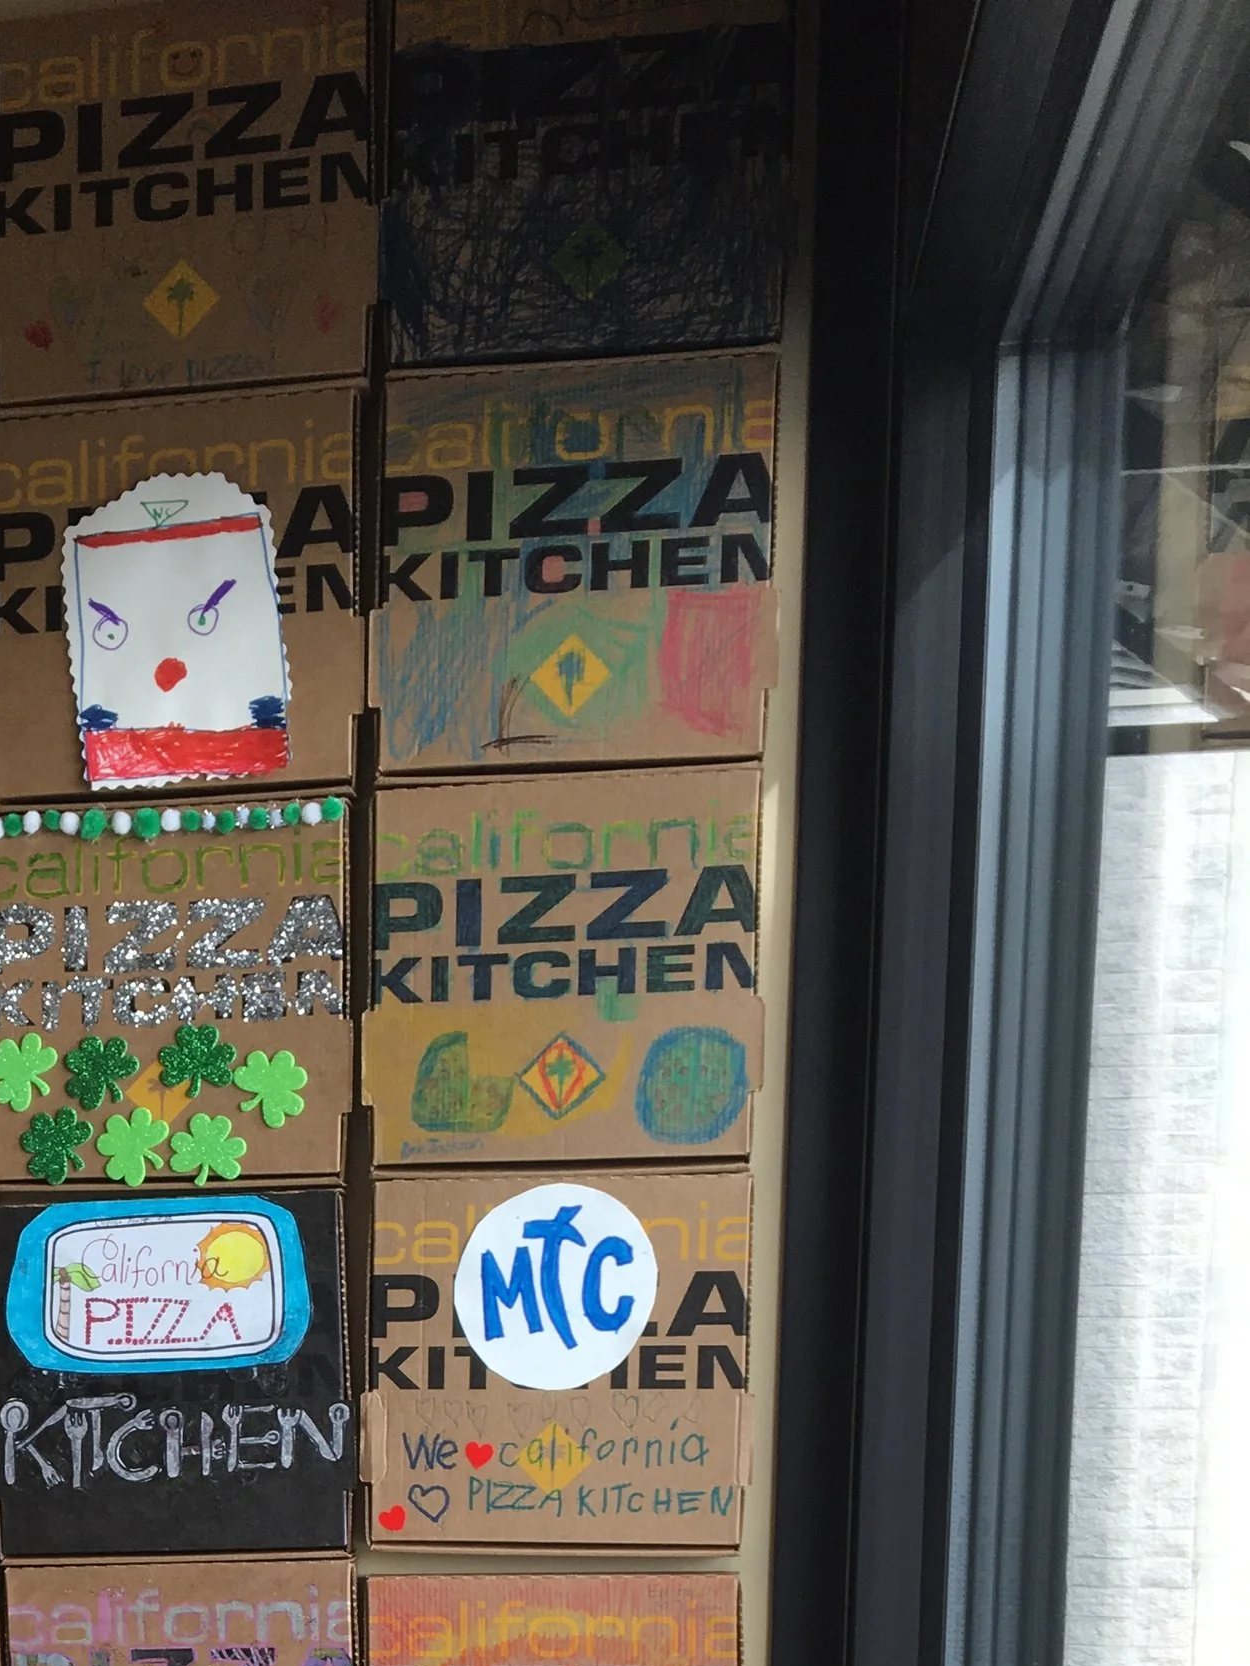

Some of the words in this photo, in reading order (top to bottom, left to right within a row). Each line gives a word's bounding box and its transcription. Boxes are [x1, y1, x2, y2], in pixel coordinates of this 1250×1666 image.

[384, 452, 772, 547] PIZZA
[385, 532, 772, 605] KITCHEN
[377, 800, 755, 878] california
[377, 864, 756, 949] PIZZA
[377, 940, 755, 1006] KITCHEN
[81, 1233, 230, 1289] California
[375, 1200, 748, 1266] calnia
[480, 1204, 636, 1349] MTC
[85, 1296, 242, 1346] PIZZA
[373, 1345, 745, 1391] KITEN
[0, 1390, 350, 1488] KITCHEN
[404, 1431, 459, 1471] We
[497, 1417, 710, 1473] california
[467, 1476, 564, 1513] PIZZA
[576, 1481, 734, 1518] KITCHEN
[12, 1586, 351, 1646] california
[368, 1597, 736, 1660] california
